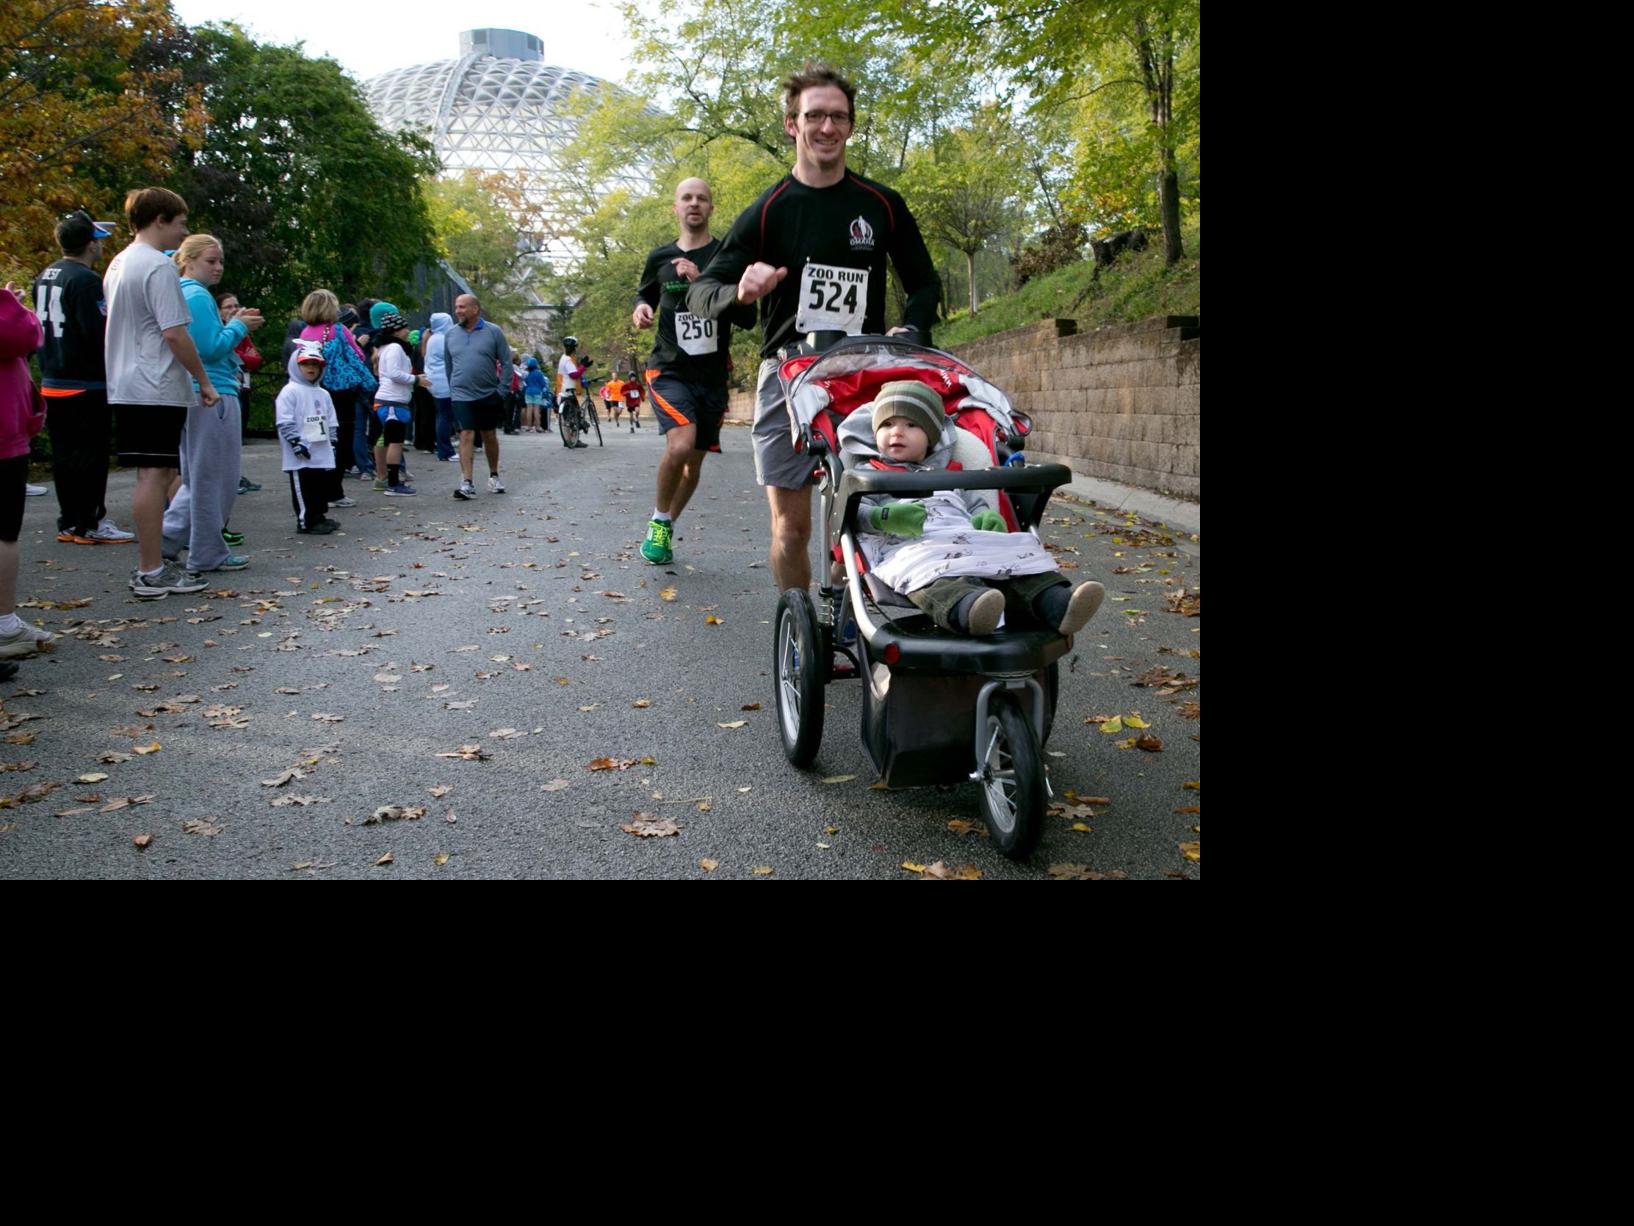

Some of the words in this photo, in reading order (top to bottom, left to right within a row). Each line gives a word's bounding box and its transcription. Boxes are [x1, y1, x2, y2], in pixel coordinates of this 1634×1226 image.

[807, 267, 834, 280] ZOO
[838, 271, 864, 283] RUN
[808, 280, 857, 314] 524
[36, 285, 66, 337] 44
[677, 314, 695, 322] ZOO
[681, 320, 713, 340] 250
[319, 421, 327, 435] 1
